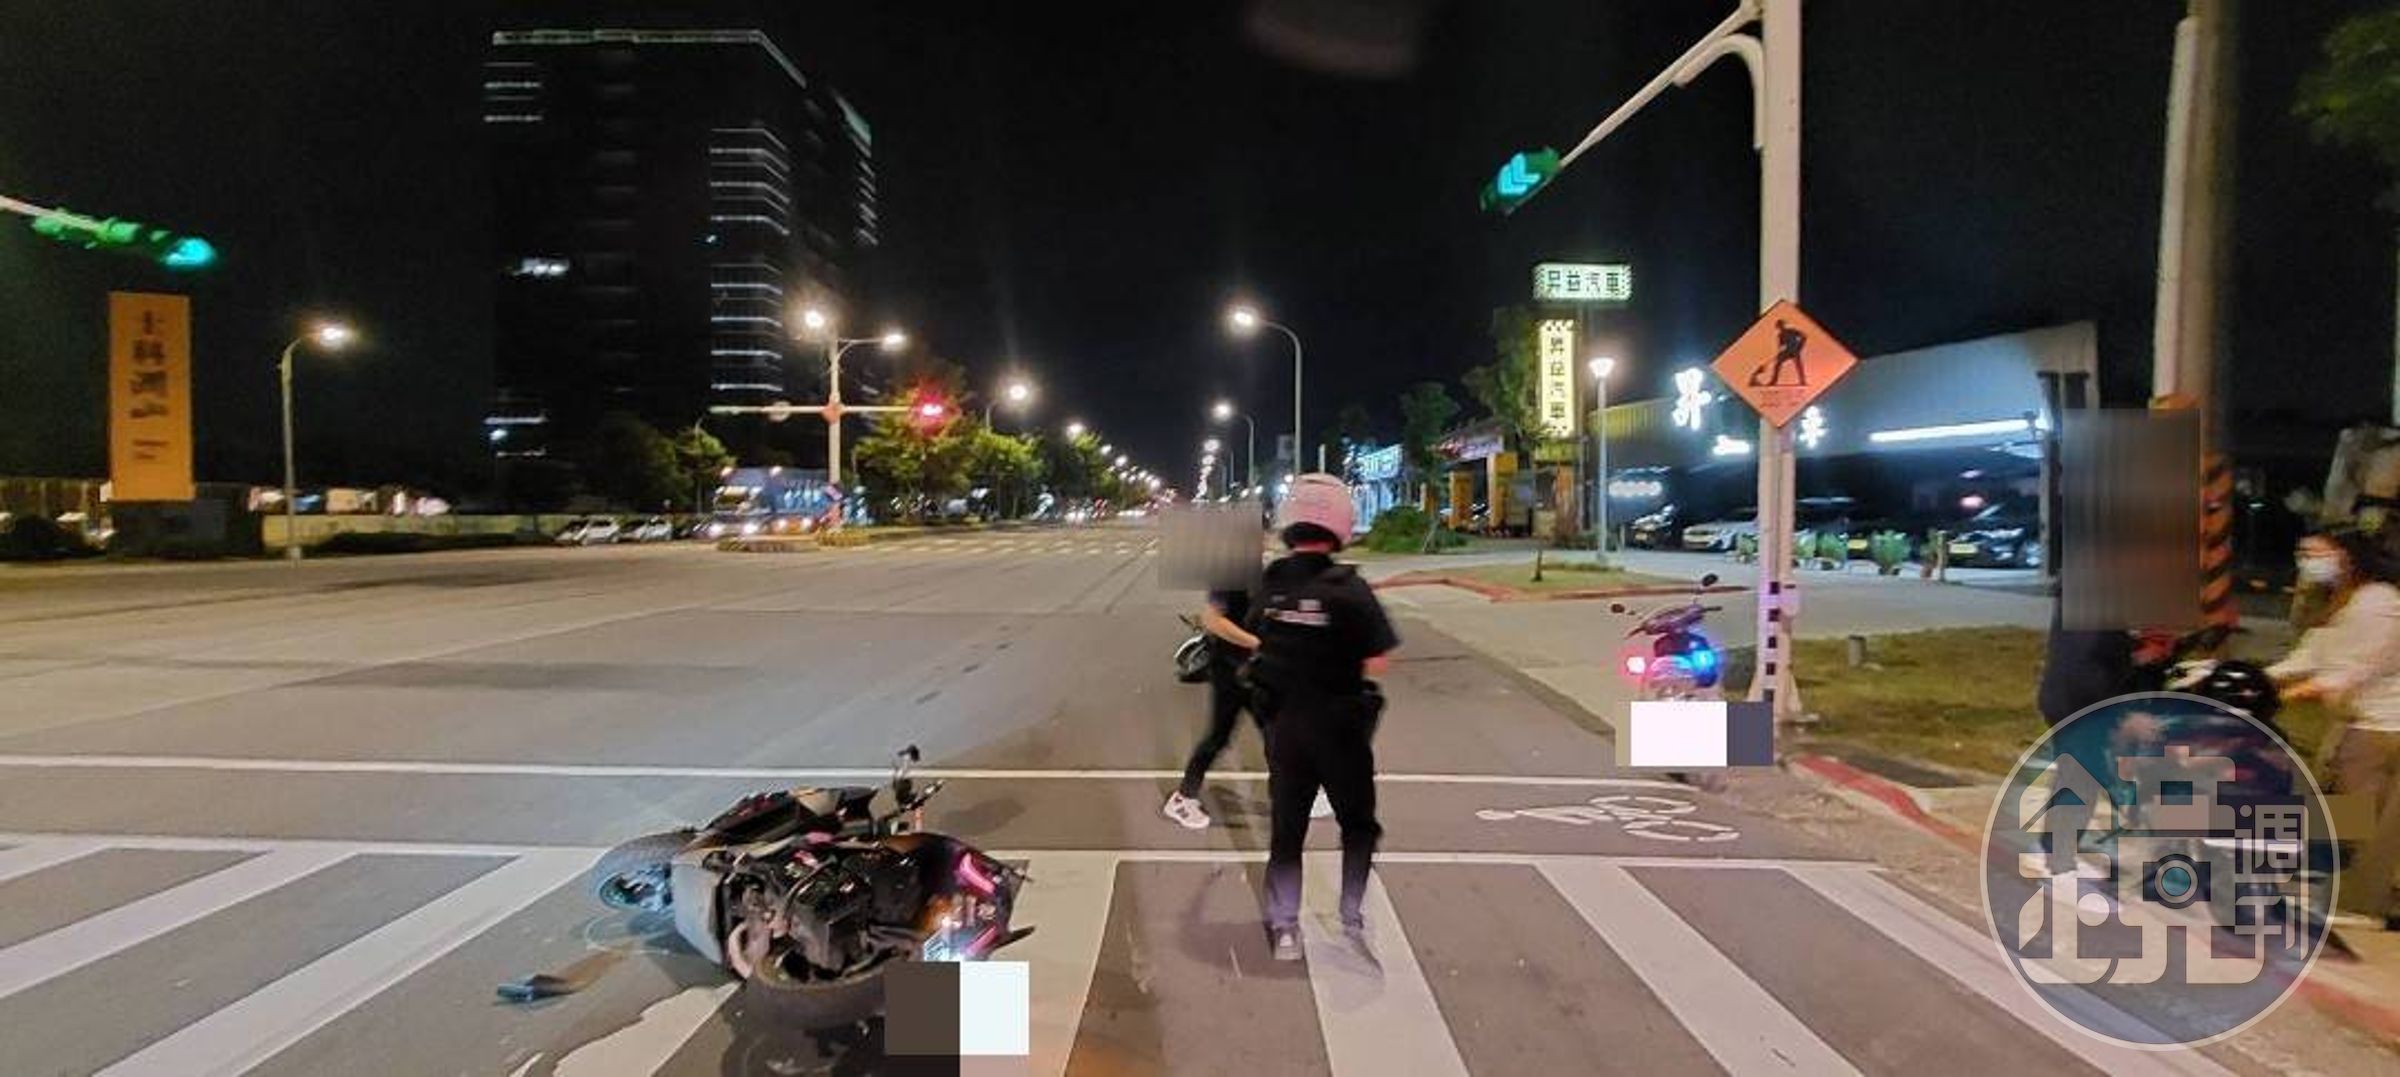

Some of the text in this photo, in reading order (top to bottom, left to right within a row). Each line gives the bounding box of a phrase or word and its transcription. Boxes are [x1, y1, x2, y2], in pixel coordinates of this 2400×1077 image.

[1547, 269, 1620, 296] 昇益汽車
[1548, 336, 1566, 420] 昇益汽車
